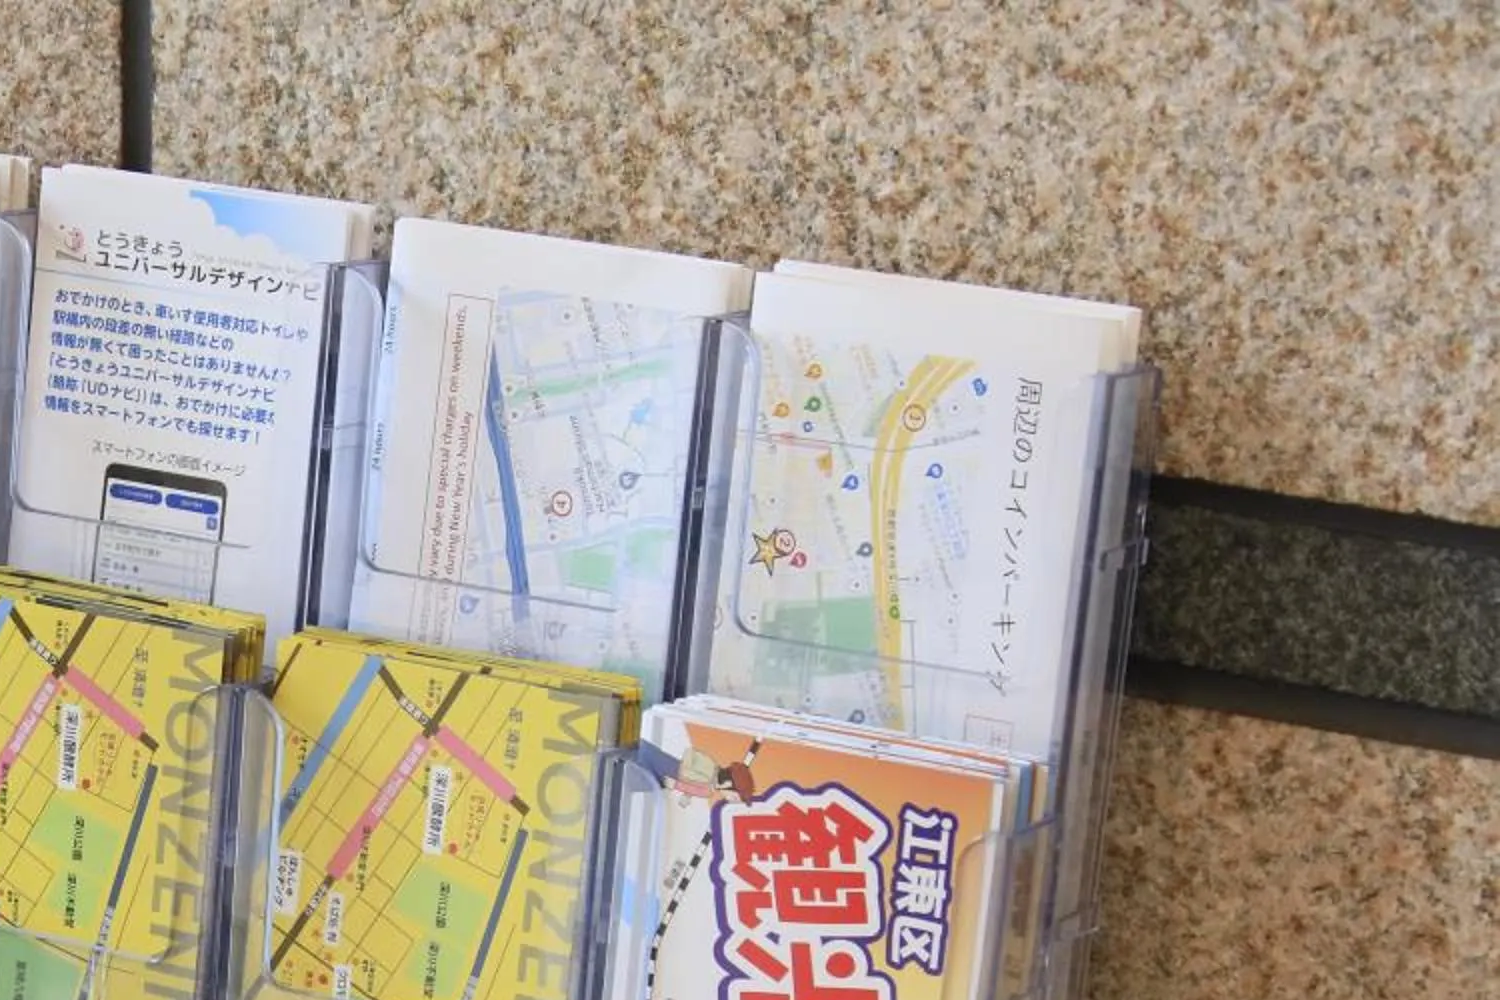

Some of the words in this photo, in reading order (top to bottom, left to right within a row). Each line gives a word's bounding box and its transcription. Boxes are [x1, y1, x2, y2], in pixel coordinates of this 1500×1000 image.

[97, 229, 182, 258] とうきょう
[437, 448, 453, 492] special
[430, 511, 443, 536] due
[434, 495, 445, 508] to
[988, 377, 1043, 697] 周辺のコインパーキング
[71, 815, 86, 862] 深川公園
[435, 881, 451, 929] 深川公園
[889, 806, 957, 973] 江東区
